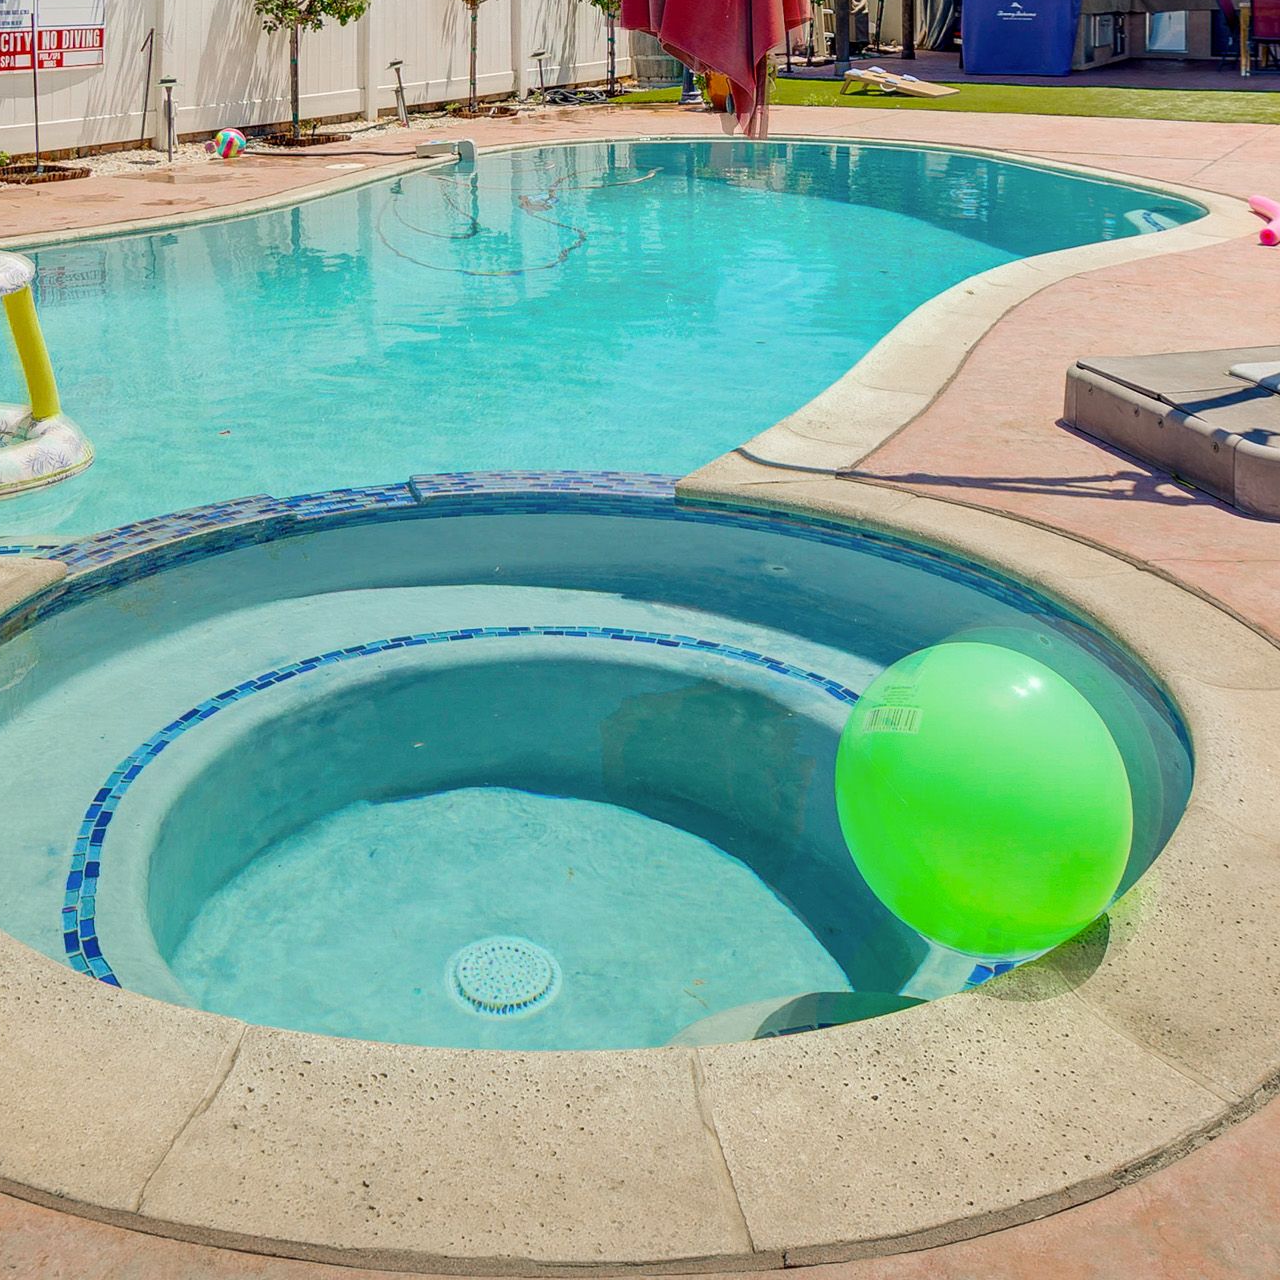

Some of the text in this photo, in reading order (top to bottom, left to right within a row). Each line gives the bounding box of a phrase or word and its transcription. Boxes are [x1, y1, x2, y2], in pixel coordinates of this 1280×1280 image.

[42, 30, 100, 50] NO DIVING
[0, 56, 15, 68] SPA
